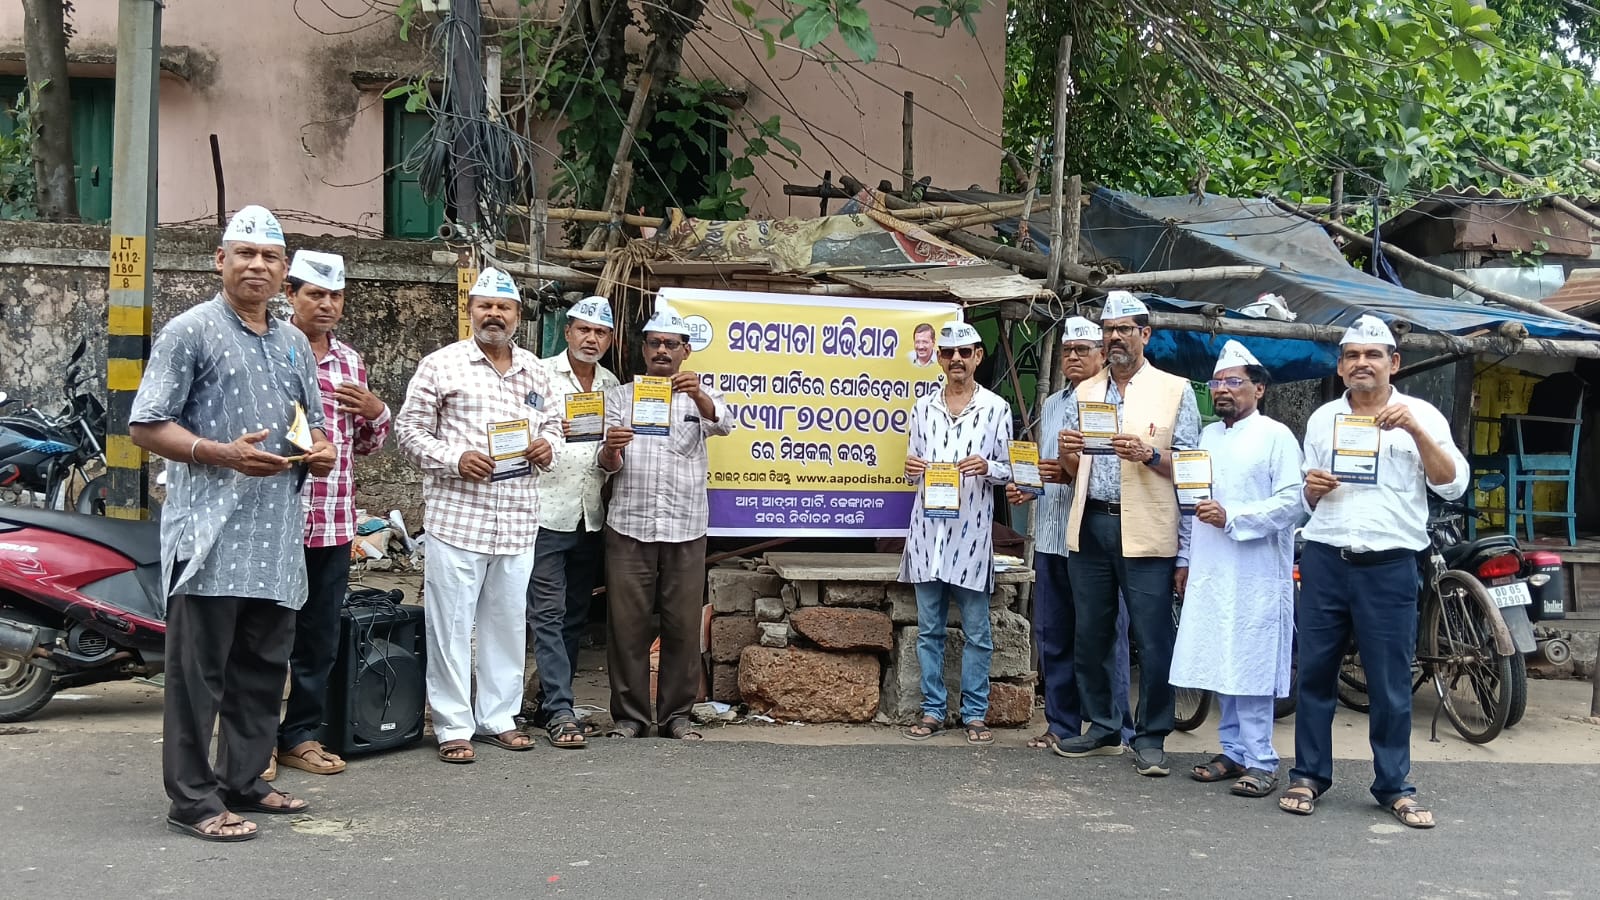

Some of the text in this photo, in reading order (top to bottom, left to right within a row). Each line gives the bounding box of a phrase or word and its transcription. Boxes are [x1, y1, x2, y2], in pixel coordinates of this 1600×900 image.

[121, 237, 134, 249] LT
[116, 263, 133, 273] 180
[123, 278, 130, 288] 8
[465, 325, 470, 336] 7
[728, 316, 898, 358] ସଦସ୍ୟତା ଅଭିଯାନ
[772, 371, 824, 396] ପାର୍ଟିରେ
[752, 441, 775, 460] ରେ
[838, 443, 877, 466] କରନ୍ତୁ
[743, 473, 766, 482] ଯୋଗ
[735, 496, 758, 509] ଆମ୍
[755, 512, 785, 523] ସଦର
[789, 510, 831, 523] ନିର୍ବାଚନ
